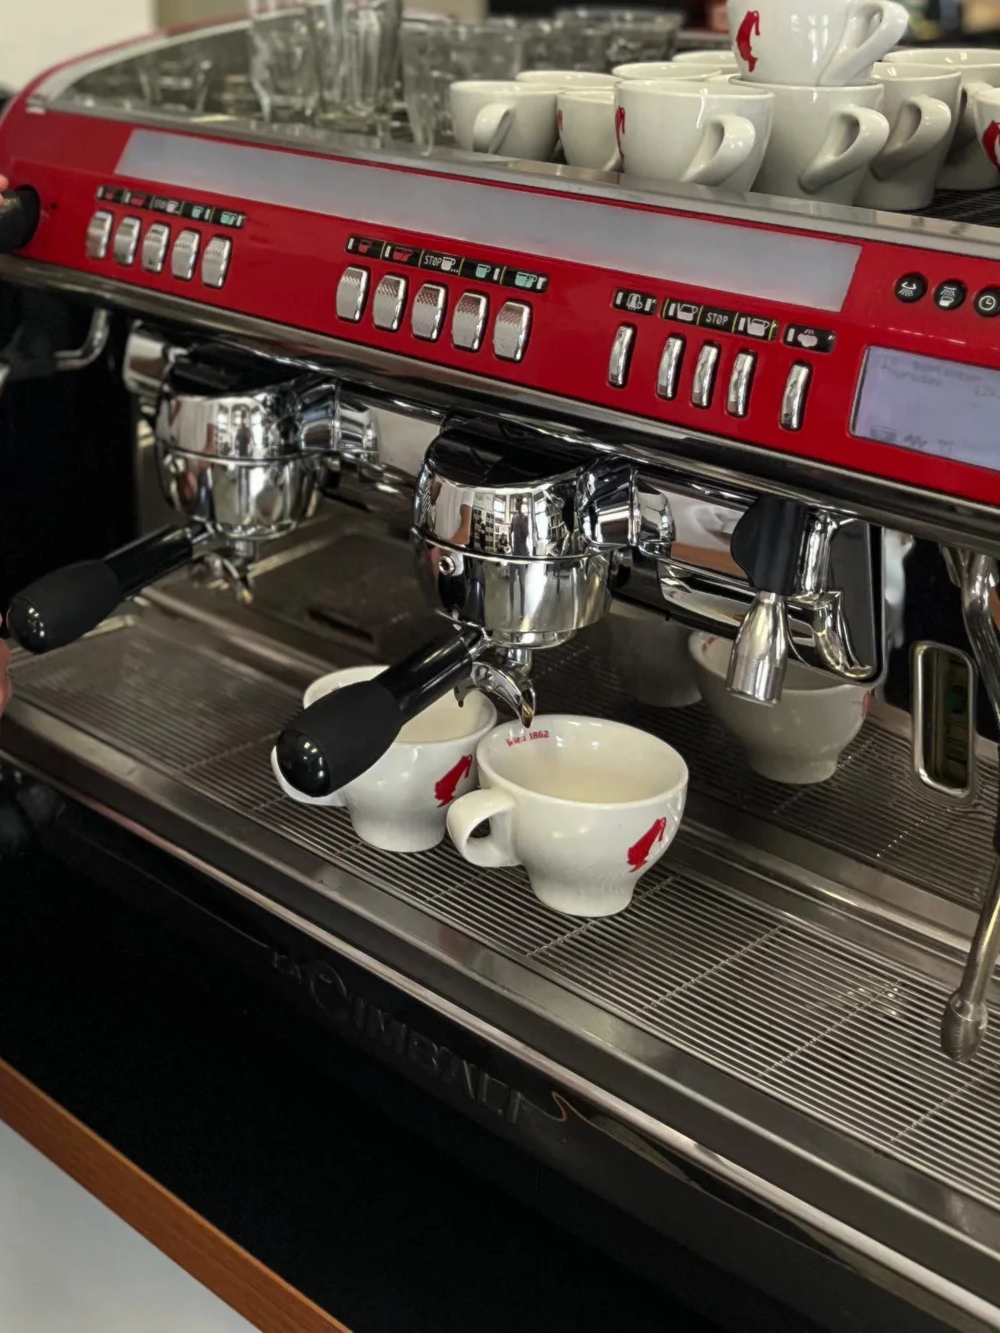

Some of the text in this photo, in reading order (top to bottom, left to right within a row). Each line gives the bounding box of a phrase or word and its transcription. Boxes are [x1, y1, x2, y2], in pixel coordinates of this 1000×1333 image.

[423, 254, 442, 267] STOP
[705, 312, 729, 326] STOP
[529, 730, 550, 740] 1862
